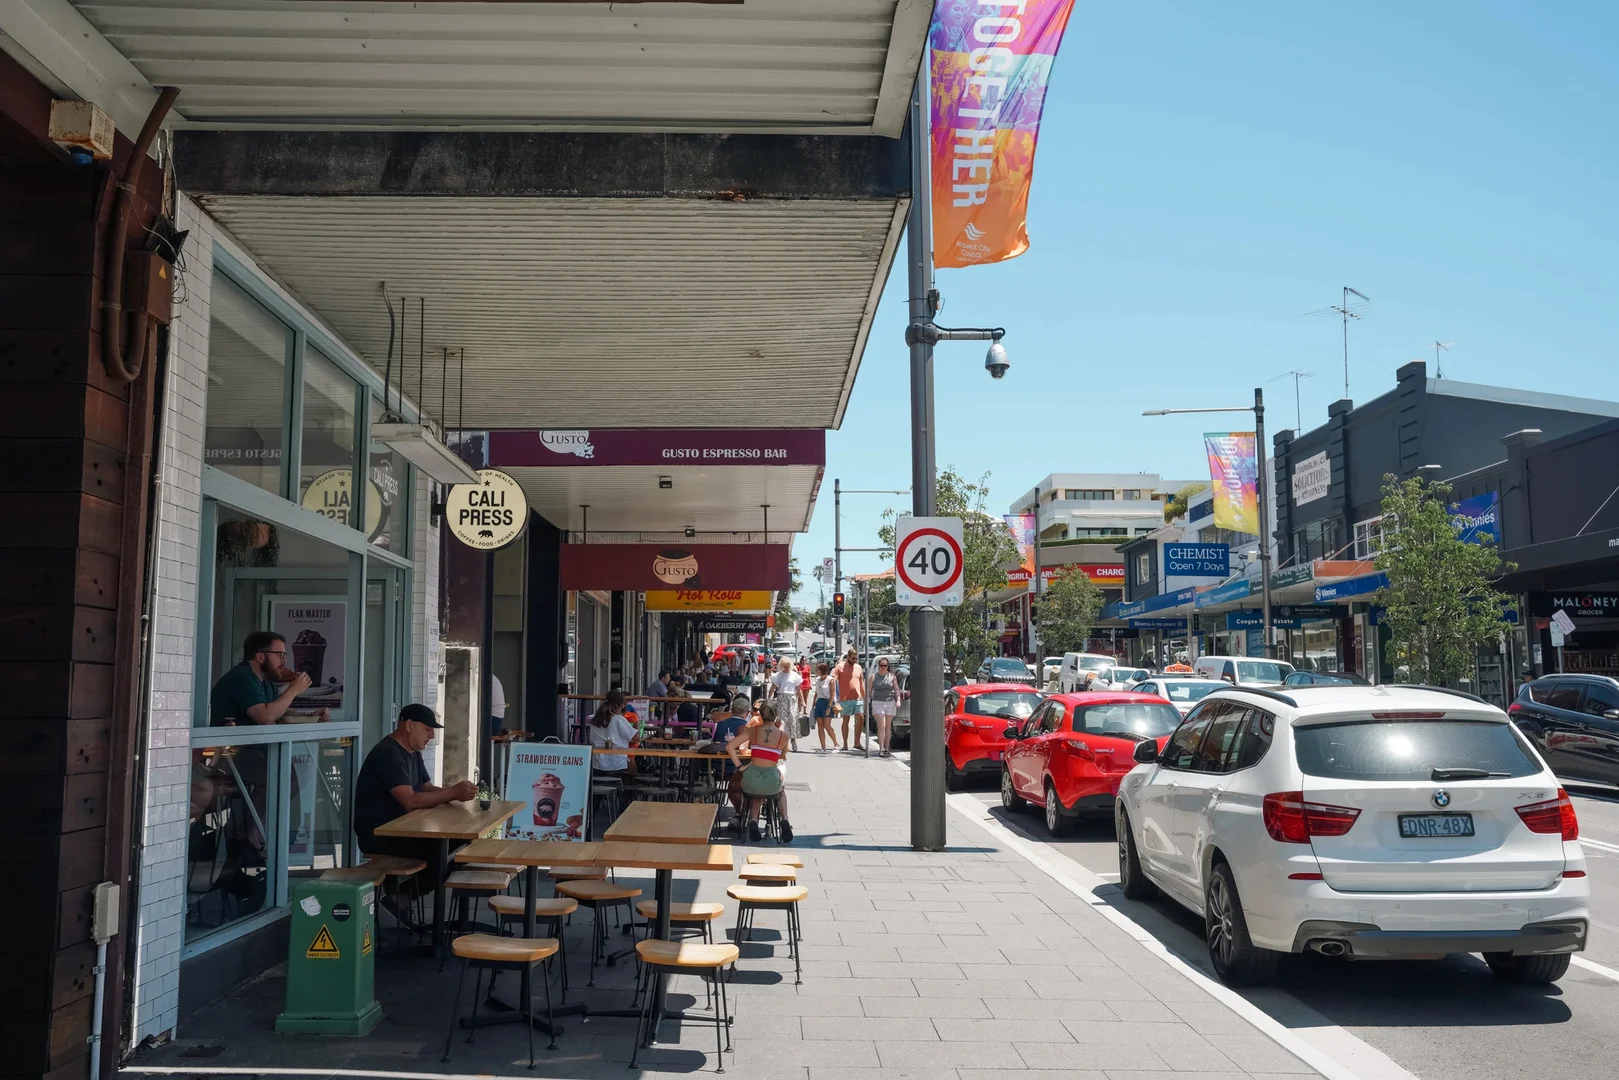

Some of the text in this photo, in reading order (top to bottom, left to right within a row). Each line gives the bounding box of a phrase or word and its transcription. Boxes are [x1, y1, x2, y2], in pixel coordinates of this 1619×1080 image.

[952, 0, 1027, 207] TOGETHER
[541, 430, 586, 444] GUSTO
[662, 448, 787, 458] GUSTO ESPRESSO BAR
[495, 473, 514, 486] HEALTH
[1294, 468, 1329, 492] SOLICITORS
[468, 490, 505, 507] CALI
[459, 509, 513, 526] PRESS
[457, 530, 475, 544] COFFEE
[496, 530, 515, 545] DRINKS
[1169, 548, 1225, 559] CHEMIST
[908, 547, 951, 575] 40
[1169, 561, 1225, 572] Open 7 Days
[655, 561, 696, 576] GUSTO
[1321, 587, 1337, 597] Vinnies
[288, 609, 331, 618] FLAX MASTER
[516, 754, 584, 766] STRAWBERRY GAINS
